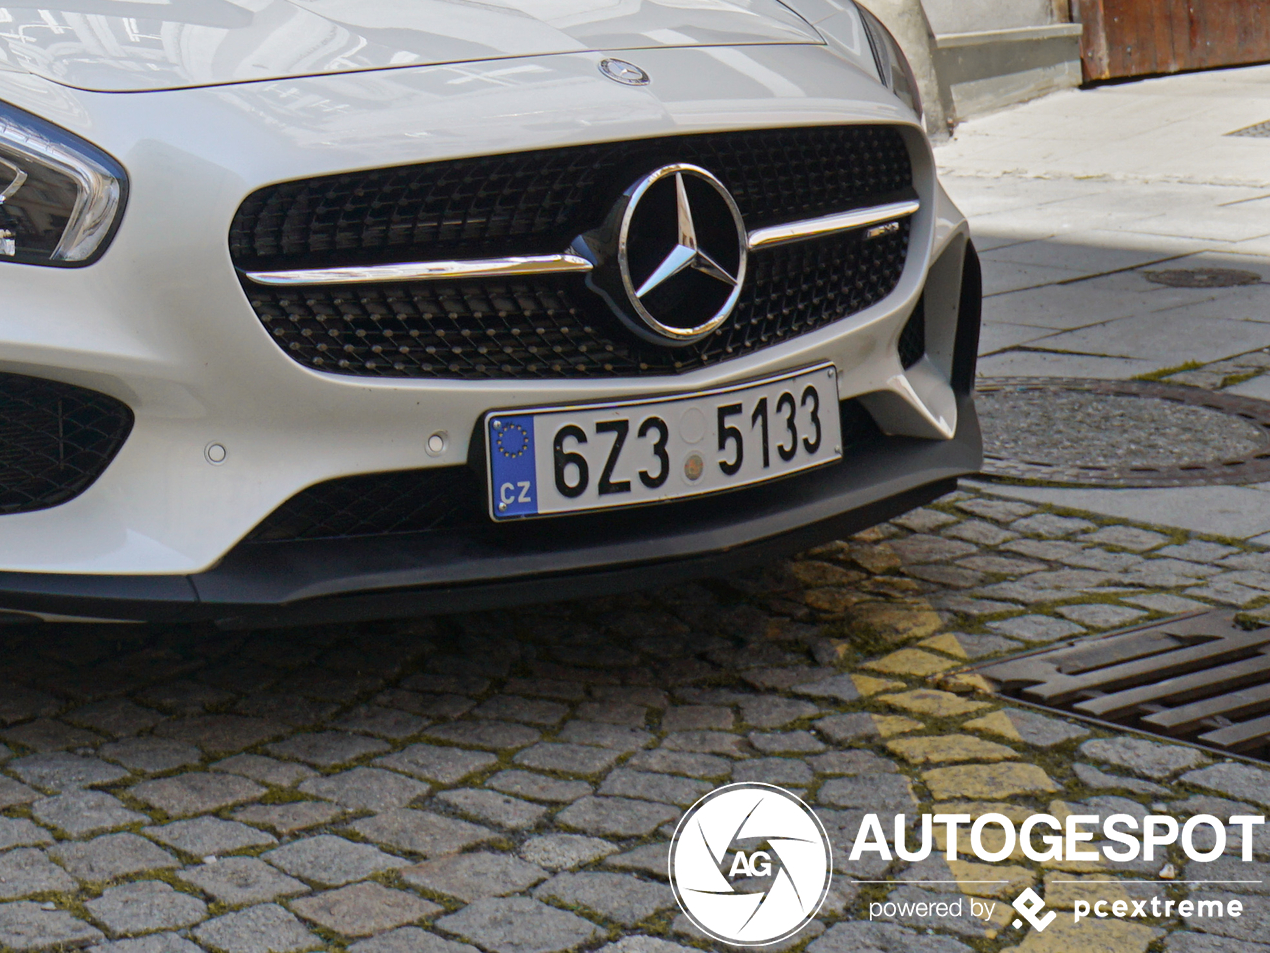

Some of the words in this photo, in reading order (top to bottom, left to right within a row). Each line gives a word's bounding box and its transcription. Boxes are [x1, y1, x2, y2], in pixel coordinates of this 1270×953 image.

[552, 416, 670, 498] 6Z3
[717, 385, 822, 476] 5133
[500, 481, 531, 505] CZ
